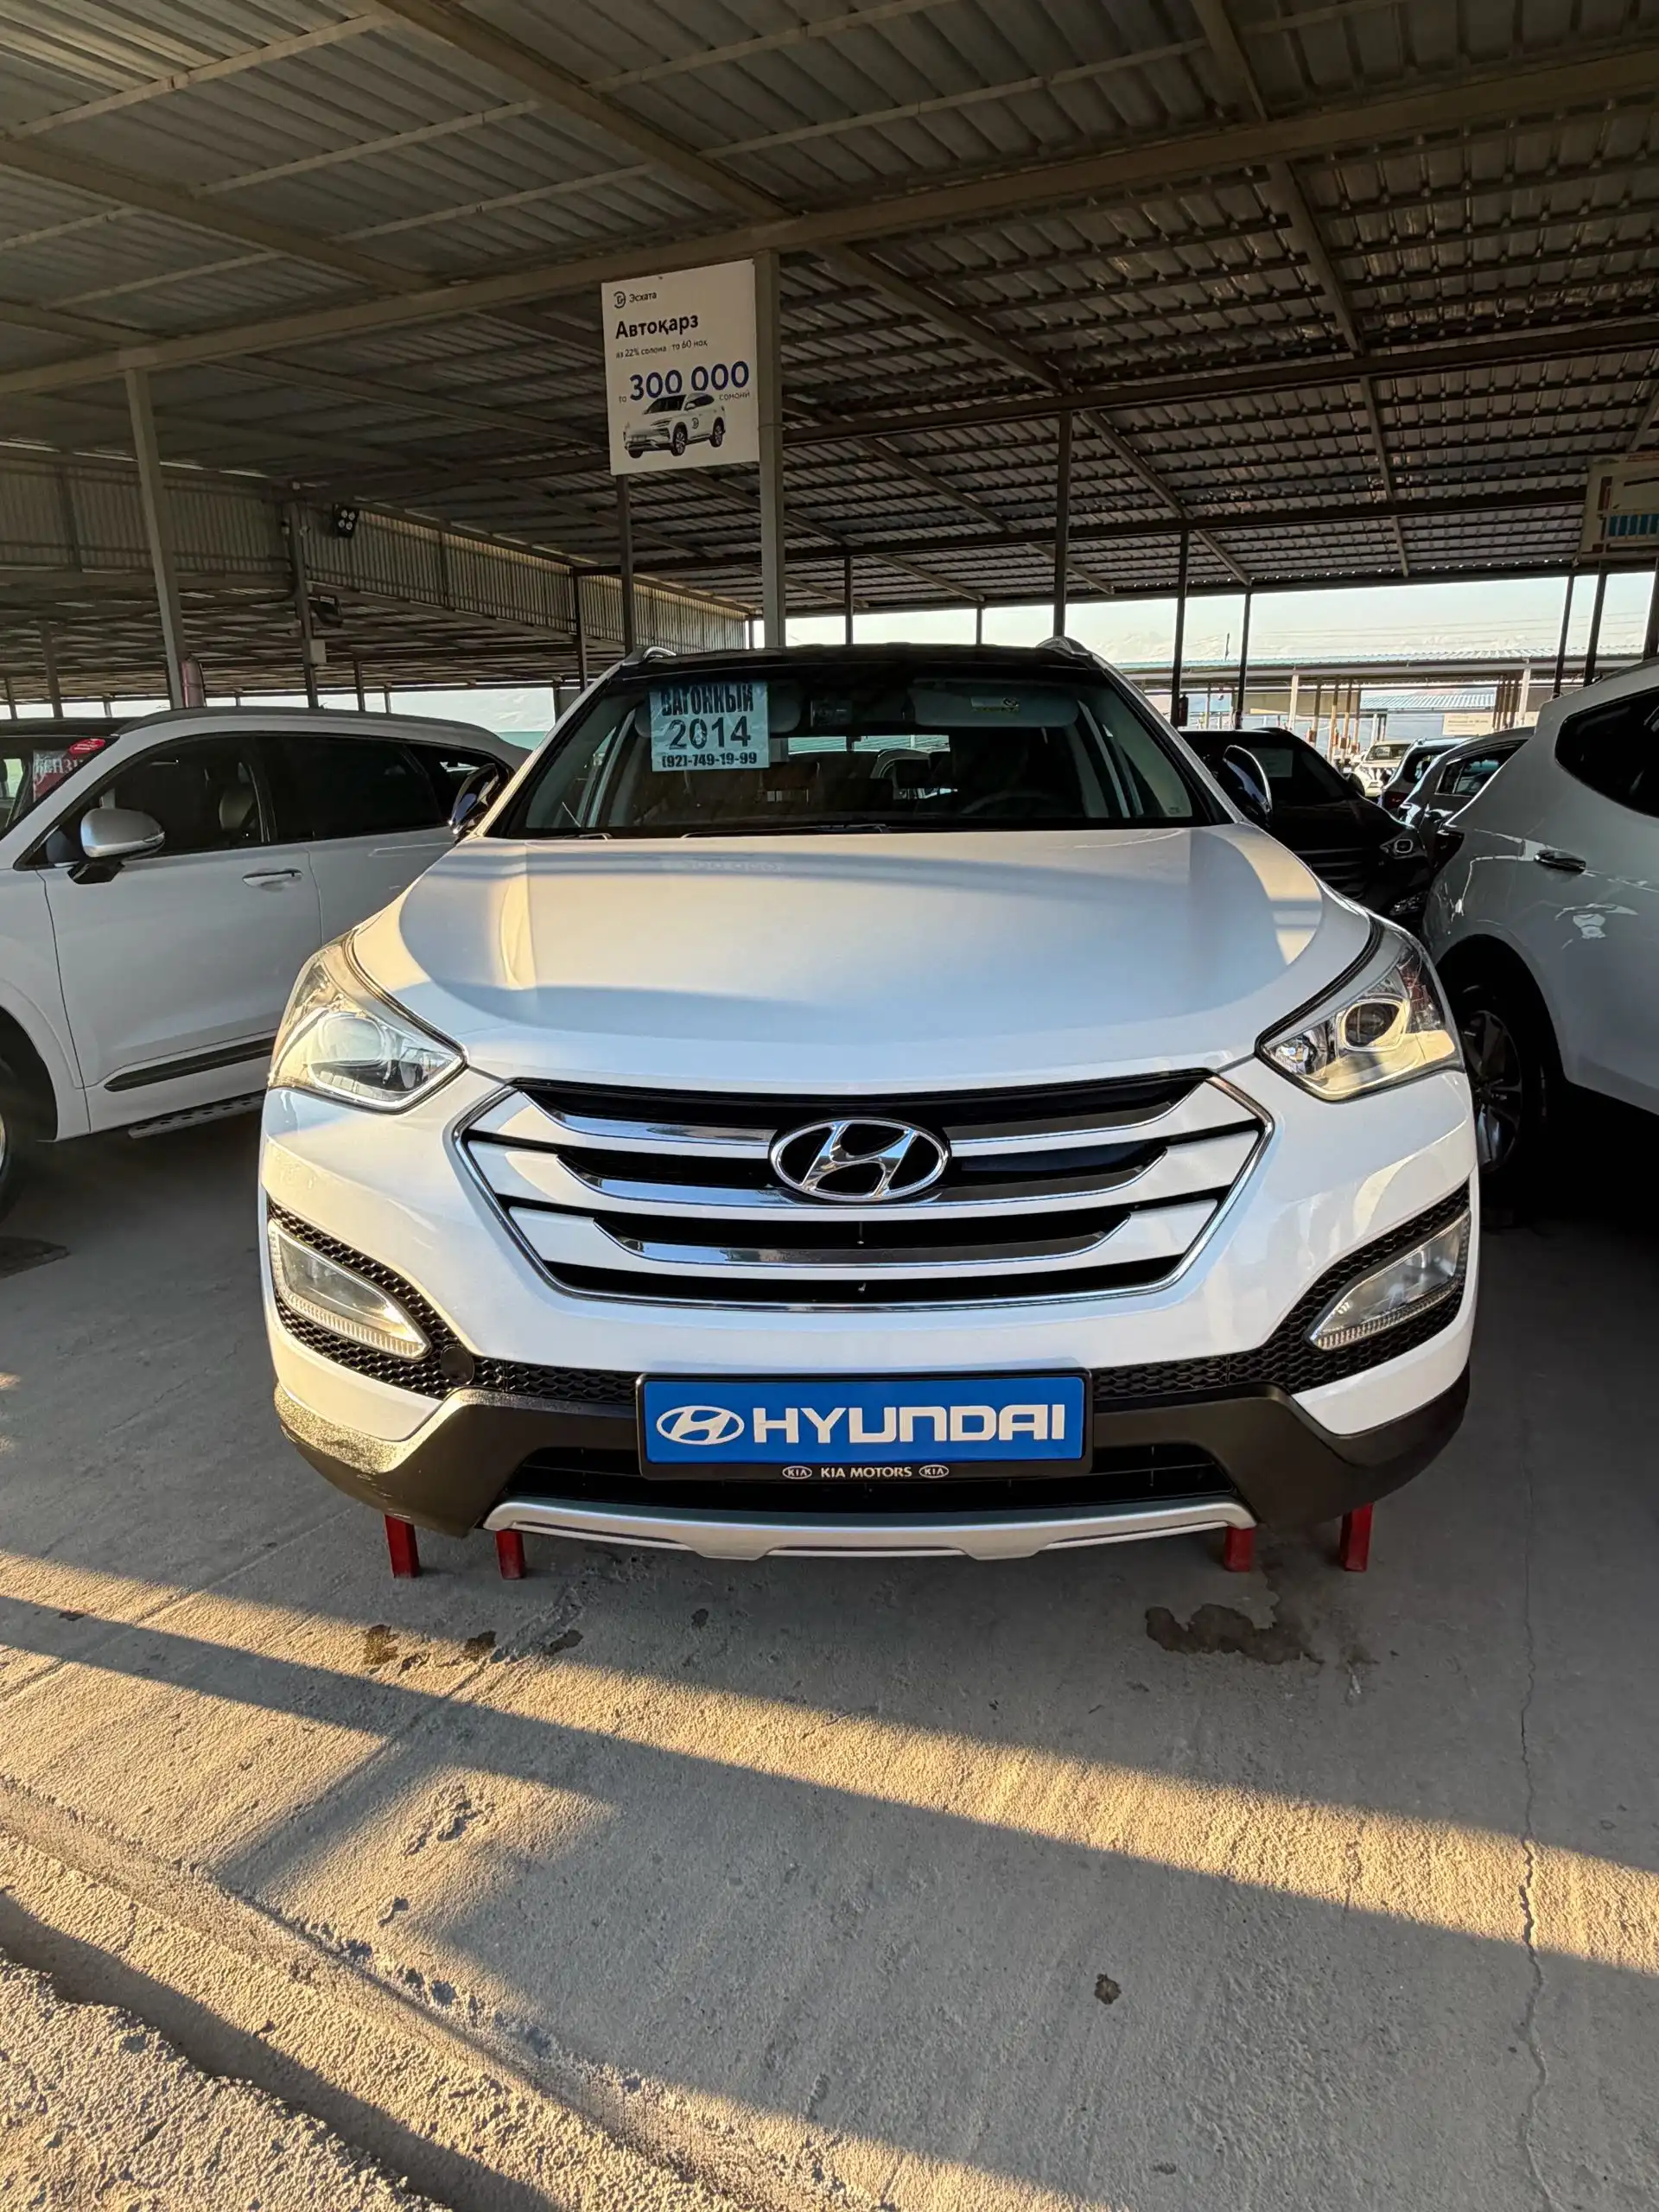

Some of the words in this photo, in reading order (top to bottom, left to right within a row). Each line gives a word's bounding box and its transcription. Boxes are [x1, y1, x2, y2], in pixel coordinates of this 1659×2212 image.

[629, 291, 657, 303] Эсхата
[615, 315, 699, 339] Автоқарз
[682, 340, 691, 349] 60
[630, 369, 683, 401] 300
[691, 360, 749, 391] 000
[669, 715, 751, 750] 2014
[753, 1403, 1065, 1444] HYUNDAI
[821, 1467, 846, 1478] KIA
[850, 1466, 912, 1478] MOTORS
